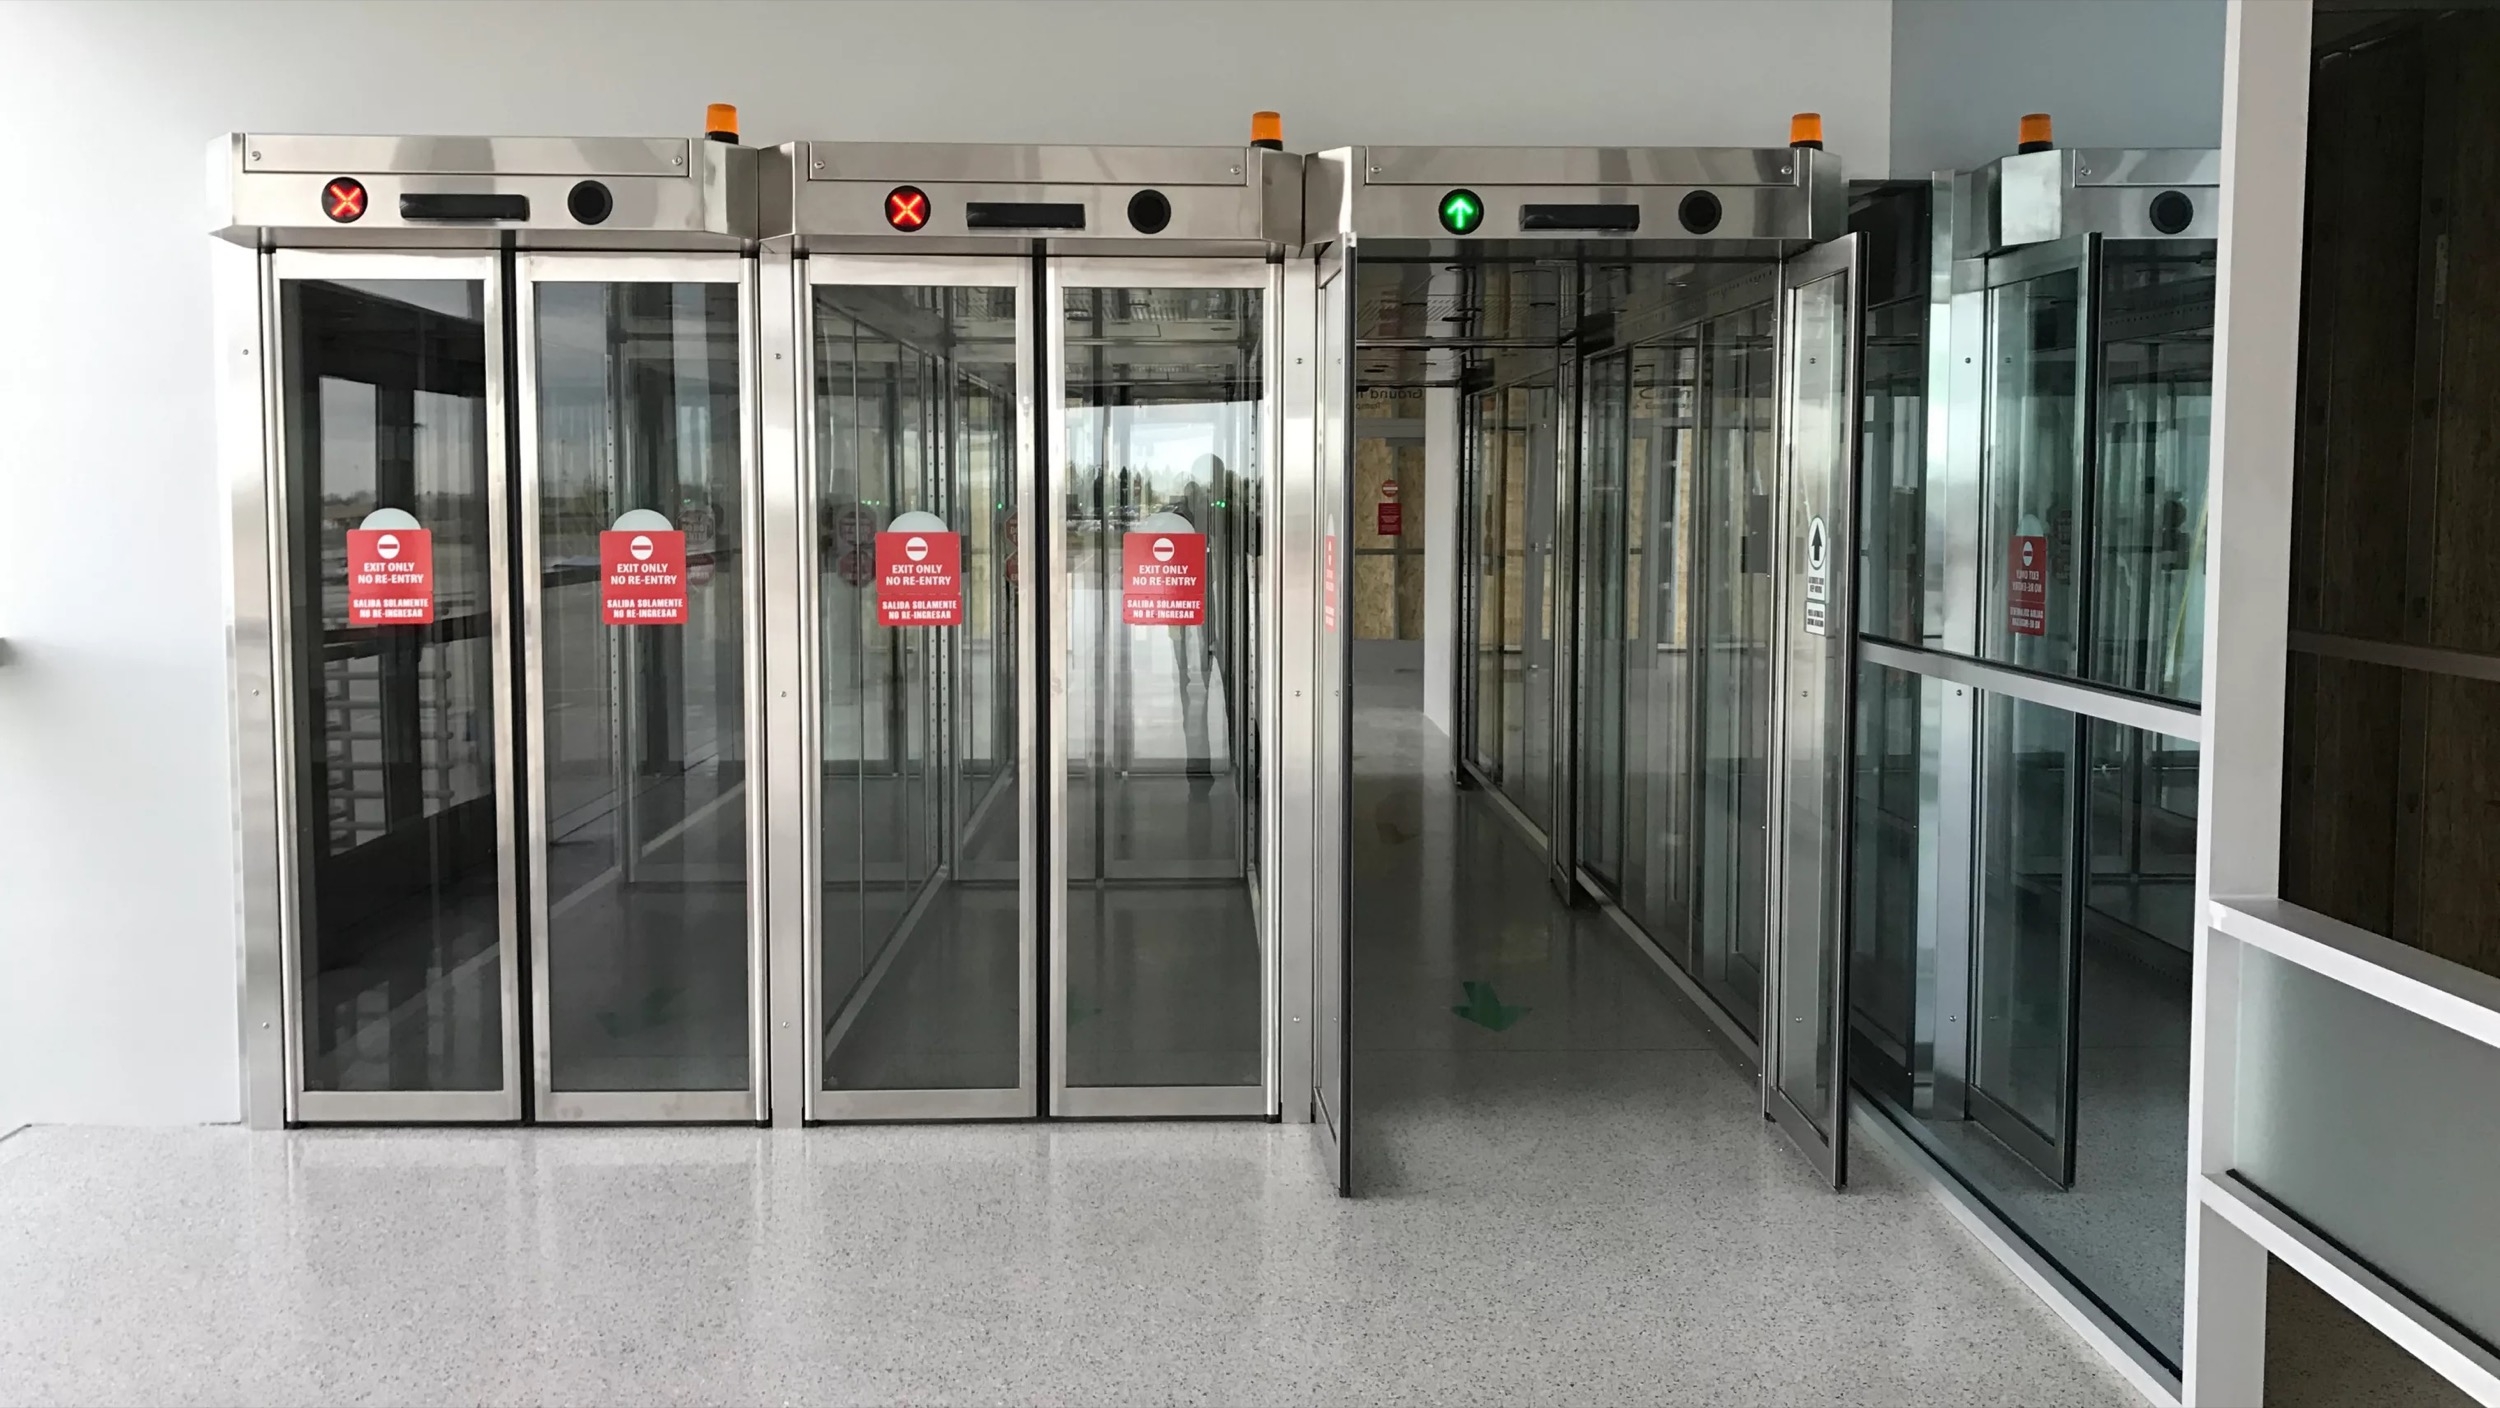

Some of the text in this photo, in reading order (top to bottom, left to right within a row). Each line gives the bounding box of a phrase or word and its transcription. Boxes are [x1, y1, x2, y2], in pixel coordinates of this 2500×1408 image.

[364, 562, 415, 572] EXIT ONLY
[617, 563, 668, 573] EXIT ONLY
[892, 564, 943, 574] EXIT ONLY
[1139, 564, 1189, 574] EXIT ONLY
[358, 574, 424, 584] NO RE-ENTRY
[611, 575, 677, 585] NO RE-ENTRY
[886, 576, 951, 586] NO RE-ENTRY
[1132, 576, 1197, 586] NO RE-ENTRY
[353, 598, 429, 608] SALIDA SOLAMENTE
[607, 598, 683, 608] SALIDA SOLAMENTE
[882, 600, 957, 610] SALIDA SOLAMENTE
[1127, 600, 1201, 609] SALIDA SOLAMENTE
[360, 609, 423, 618] NO RE-INGRESAR
[613, 609, 677, 618] NO RE-INGRESAR
[888, 610, 952, 620] NO RE-INGRESAR
[1133, 610, 1195, 619] NO RE-INGRESAR
